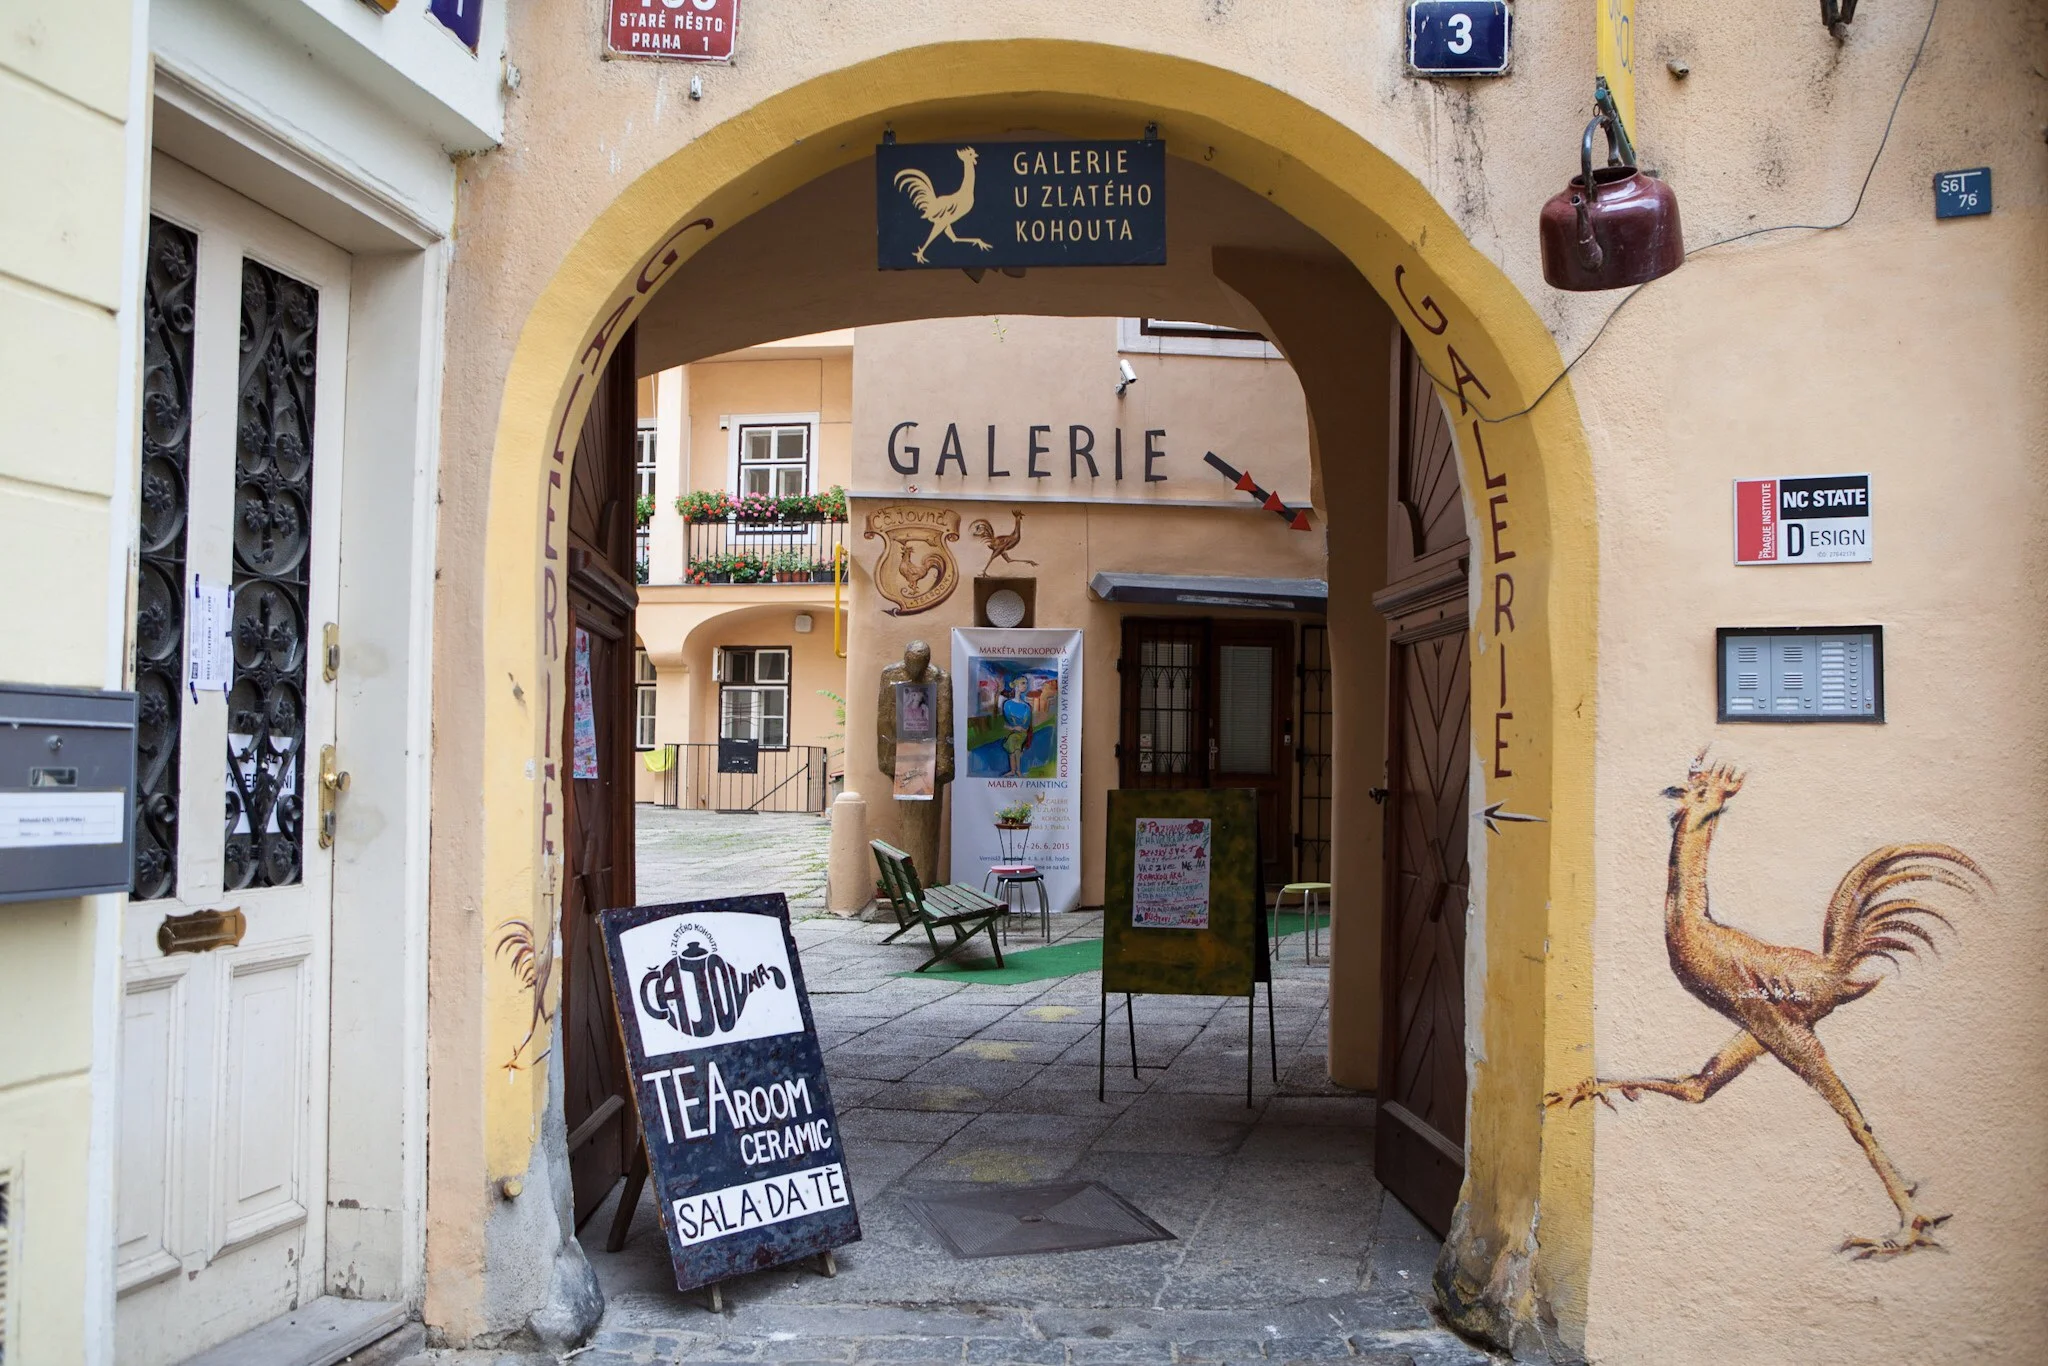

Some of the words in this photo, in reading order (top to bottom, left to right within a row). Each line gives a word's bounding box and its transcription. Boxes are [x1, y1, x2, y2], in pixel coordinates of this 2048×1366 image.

[620, 10, 666, 28] STARÉ
[674, 12, 723, 32] MĚSTO
[1447, 13, 1473, 55] 3
[632, 33, 681, 50] PRAHA
[702, 36, 709, 52] 1
[1013, 150, 1128, 175] GALERIE
[1014, 186, 1028, 208] U
[1041, 180, 1152, 208] ZLATÉHO
[1958, 193, 1978, 208] 76
[1015, 219, 1133, 243] KOHOUTA
[888, 421, 1168, 482] GALERIE
[1762, 483, 1772, 525] INSTITUTE
[1783, 491, 1809, 509] NC
[1812, 488, 1866, 508] STATE
[1395, 264, 1516, 780] GALERIE
[1762, 525, 1772, 559] PRAGUE
[980, 646, 1016, 655] MARKÉTA
[1018, 646, 1067, 655] PROKOPOVÁ
[1061, 658, 1069, 695] PARENTS
[1061, 699, 1068, 711] MY
[1061, 713, 1068, 725] TO
[987, 780, 1018, 788] MALBA
[1026, 780, 1068, 789] PAINTING
[1030, 842, 1041, 850] 26.
[1043, 842, 1051, 850] 6.
[1052, 842, 1070, 850] 2015
[670, 923, 693, 948] ZLATÉHO
[694, 923, 718, 953] KOHOUTA
[639, 953, 772, 1038] ČAJOVNA
[740, 1118, 833, 1166] CERAMIC
[807, 1167, 845, 1208] TÈ
